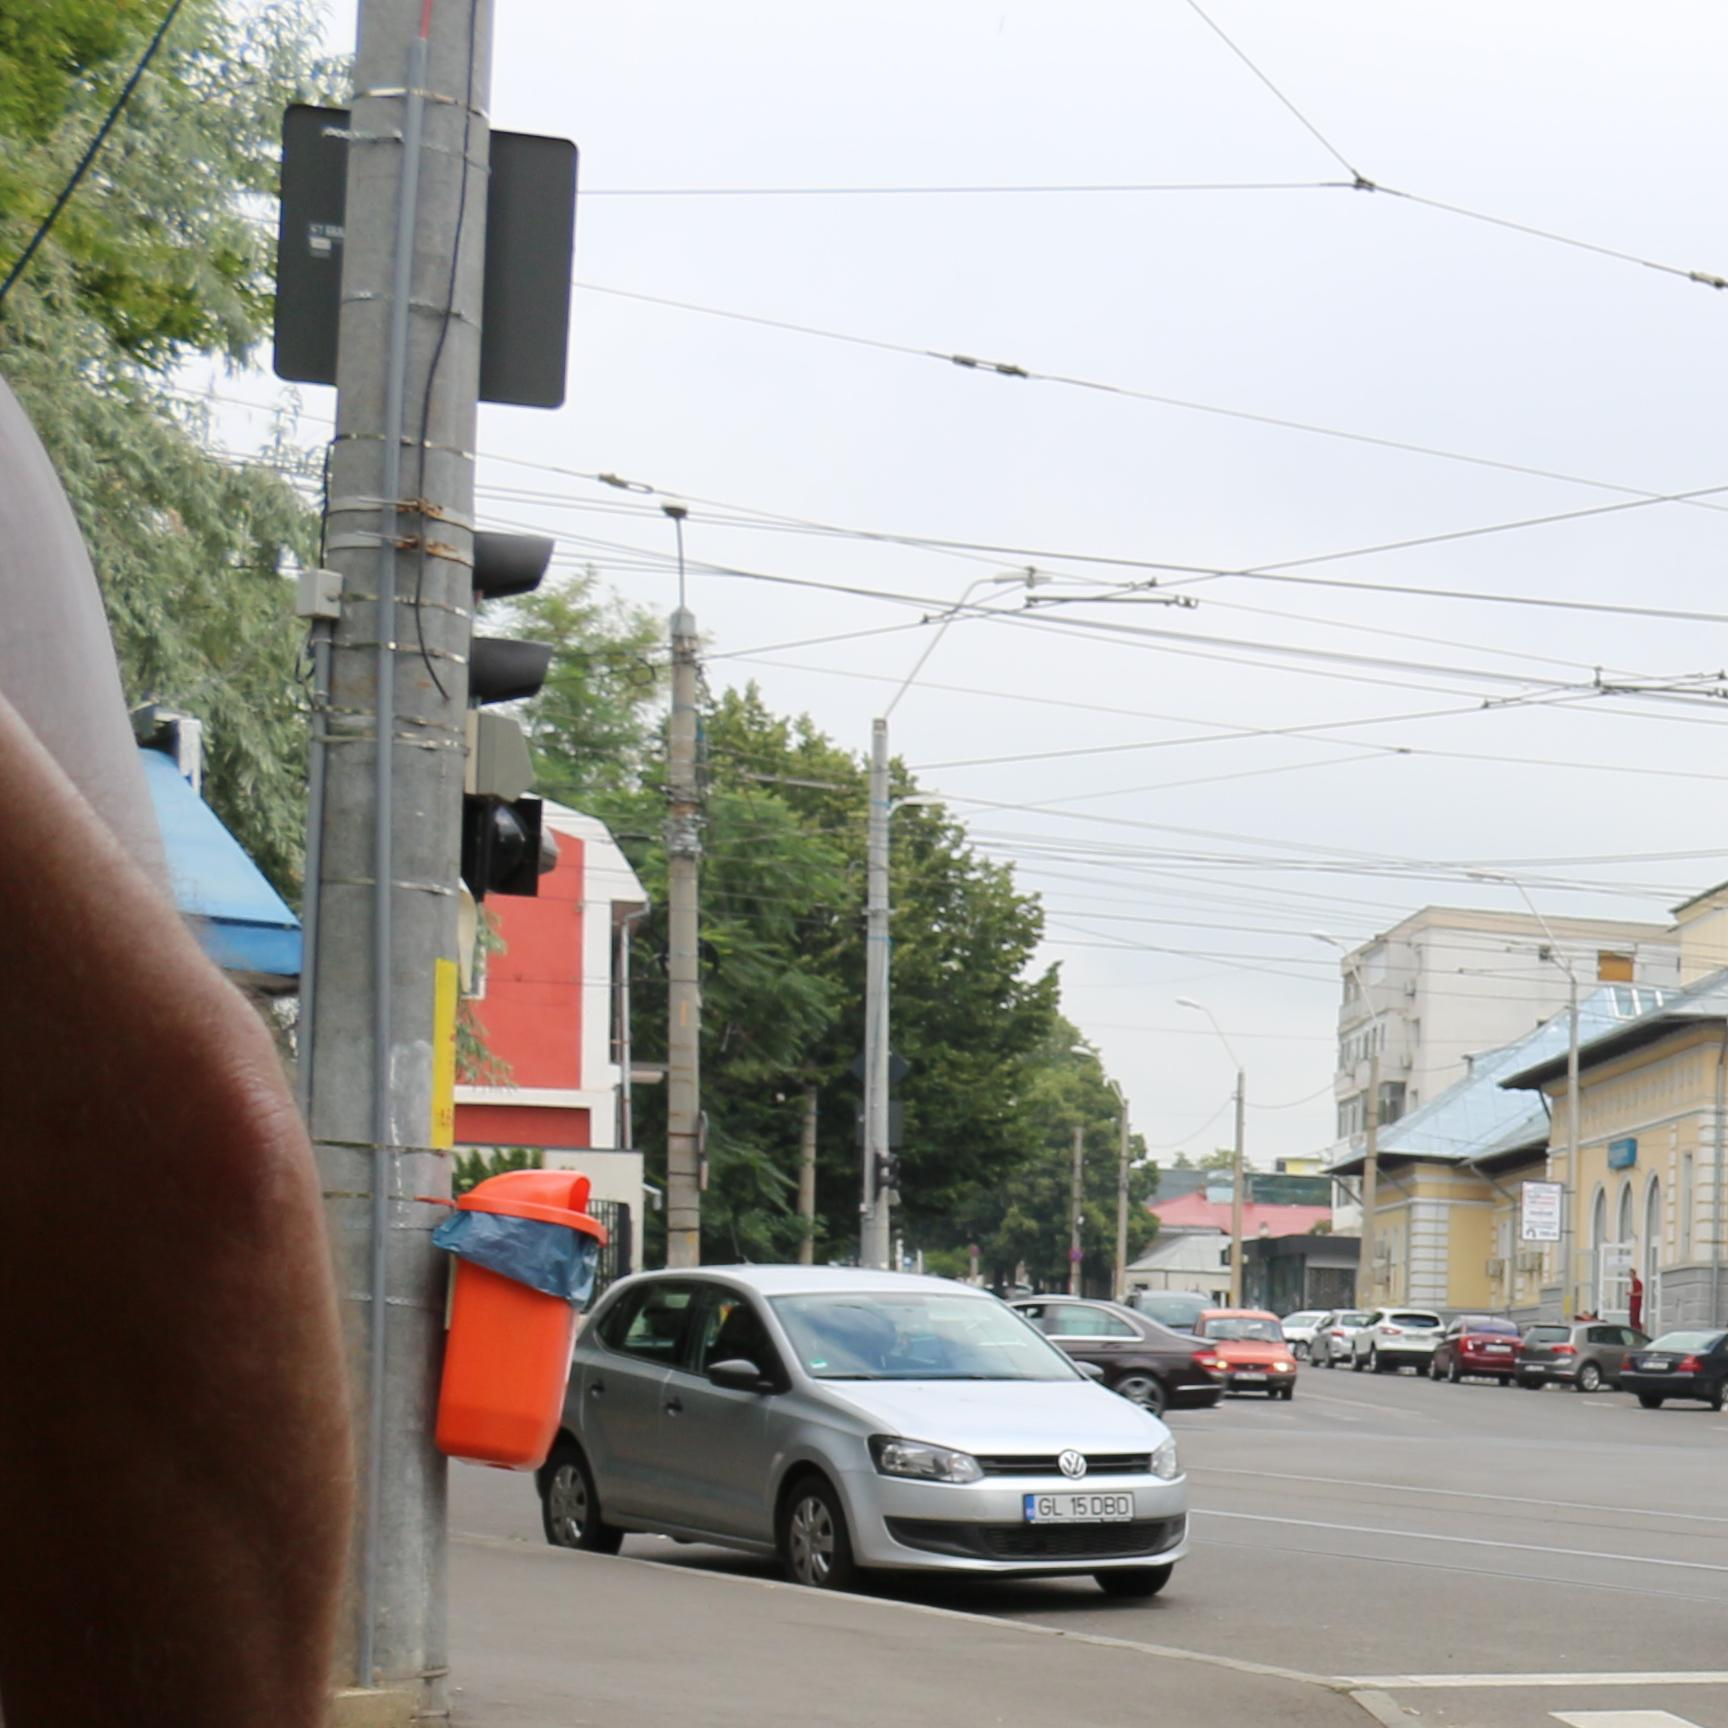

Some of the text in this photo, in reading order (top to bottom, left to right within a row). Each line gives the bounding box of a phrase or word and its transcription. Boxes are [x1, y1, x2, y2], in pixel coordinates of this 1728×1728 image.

[1039, 1496, 1129, 1516] GL 15 DBD
